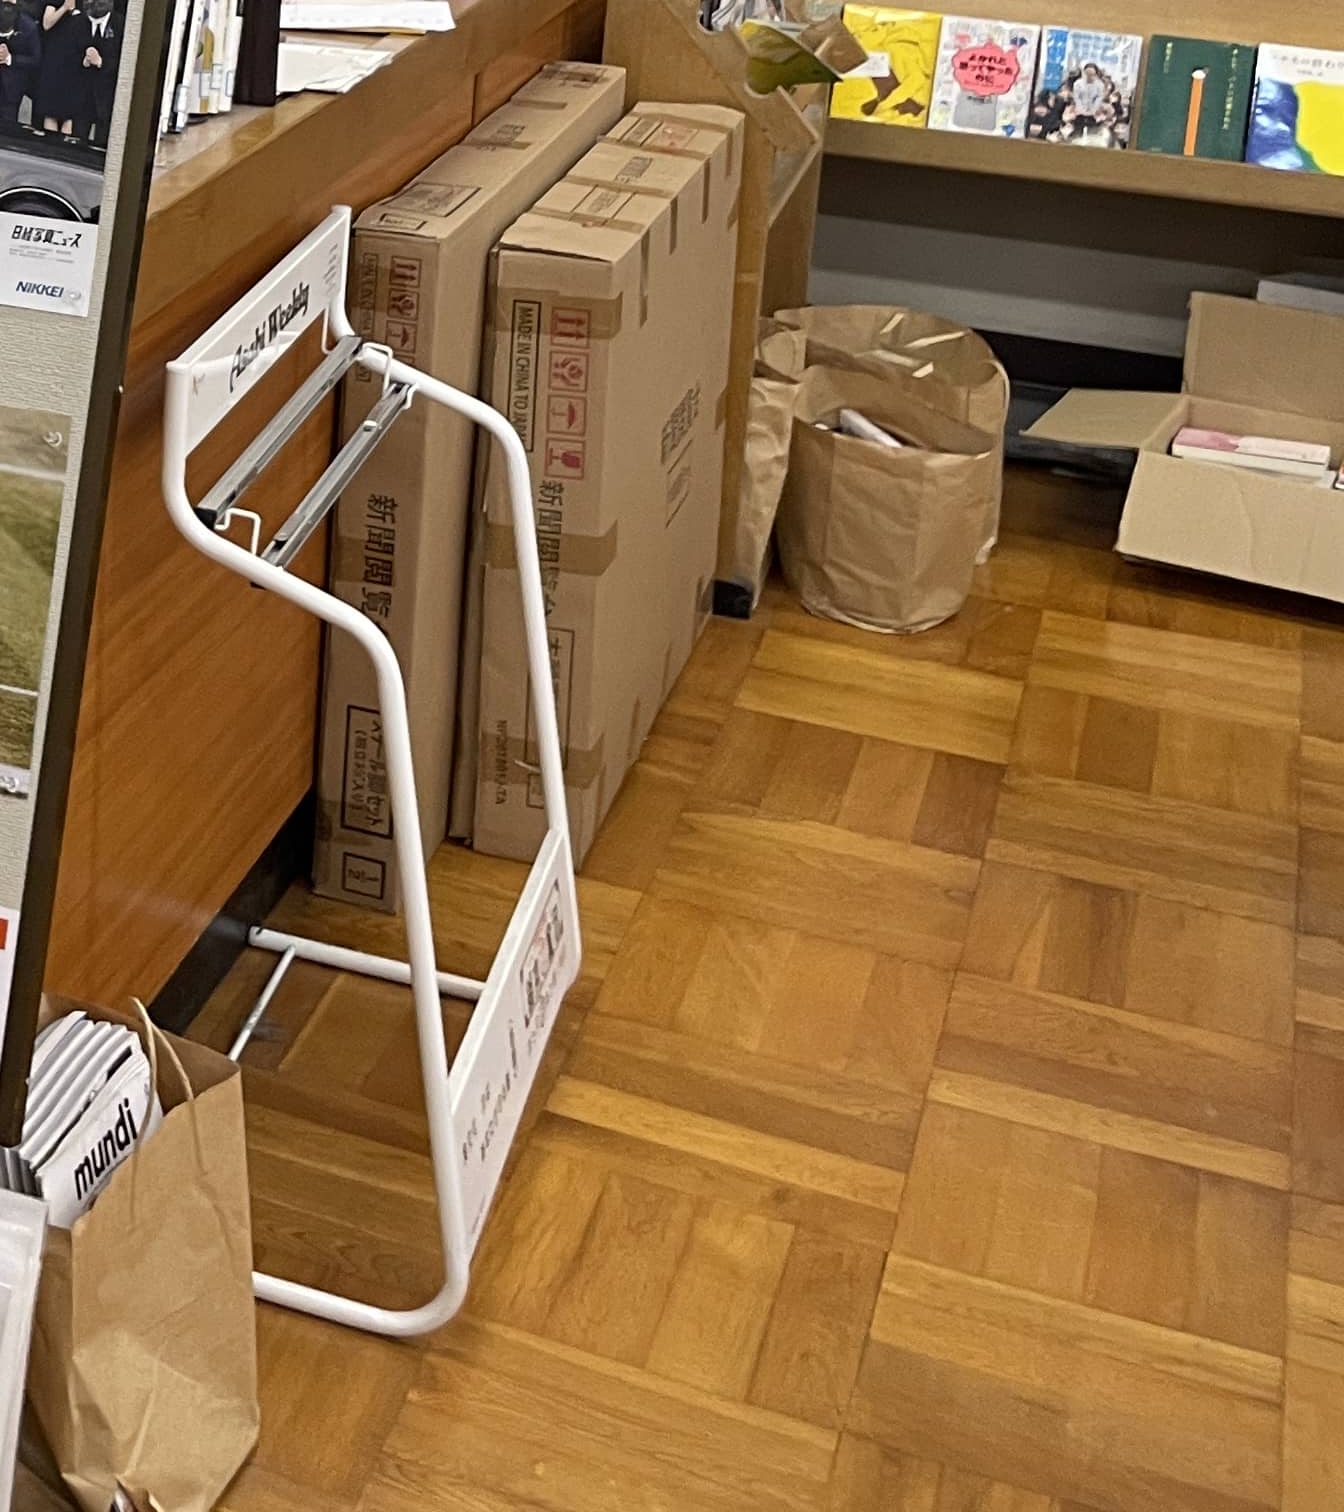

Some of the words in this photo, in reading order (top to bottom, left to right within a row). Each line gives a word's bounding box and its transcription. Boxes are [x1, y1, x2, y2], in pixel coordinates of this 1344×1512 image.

[16, 281, 64, 298] NIKKEI
[229, 320, 266, 394] Asahi
[268, 281, 310, 343] Weekly
[516, 306, 534, 340] MADE
[359, 493, 400, 628] 新聞閲覧
[73, 1097, 138, 1201] mundi
